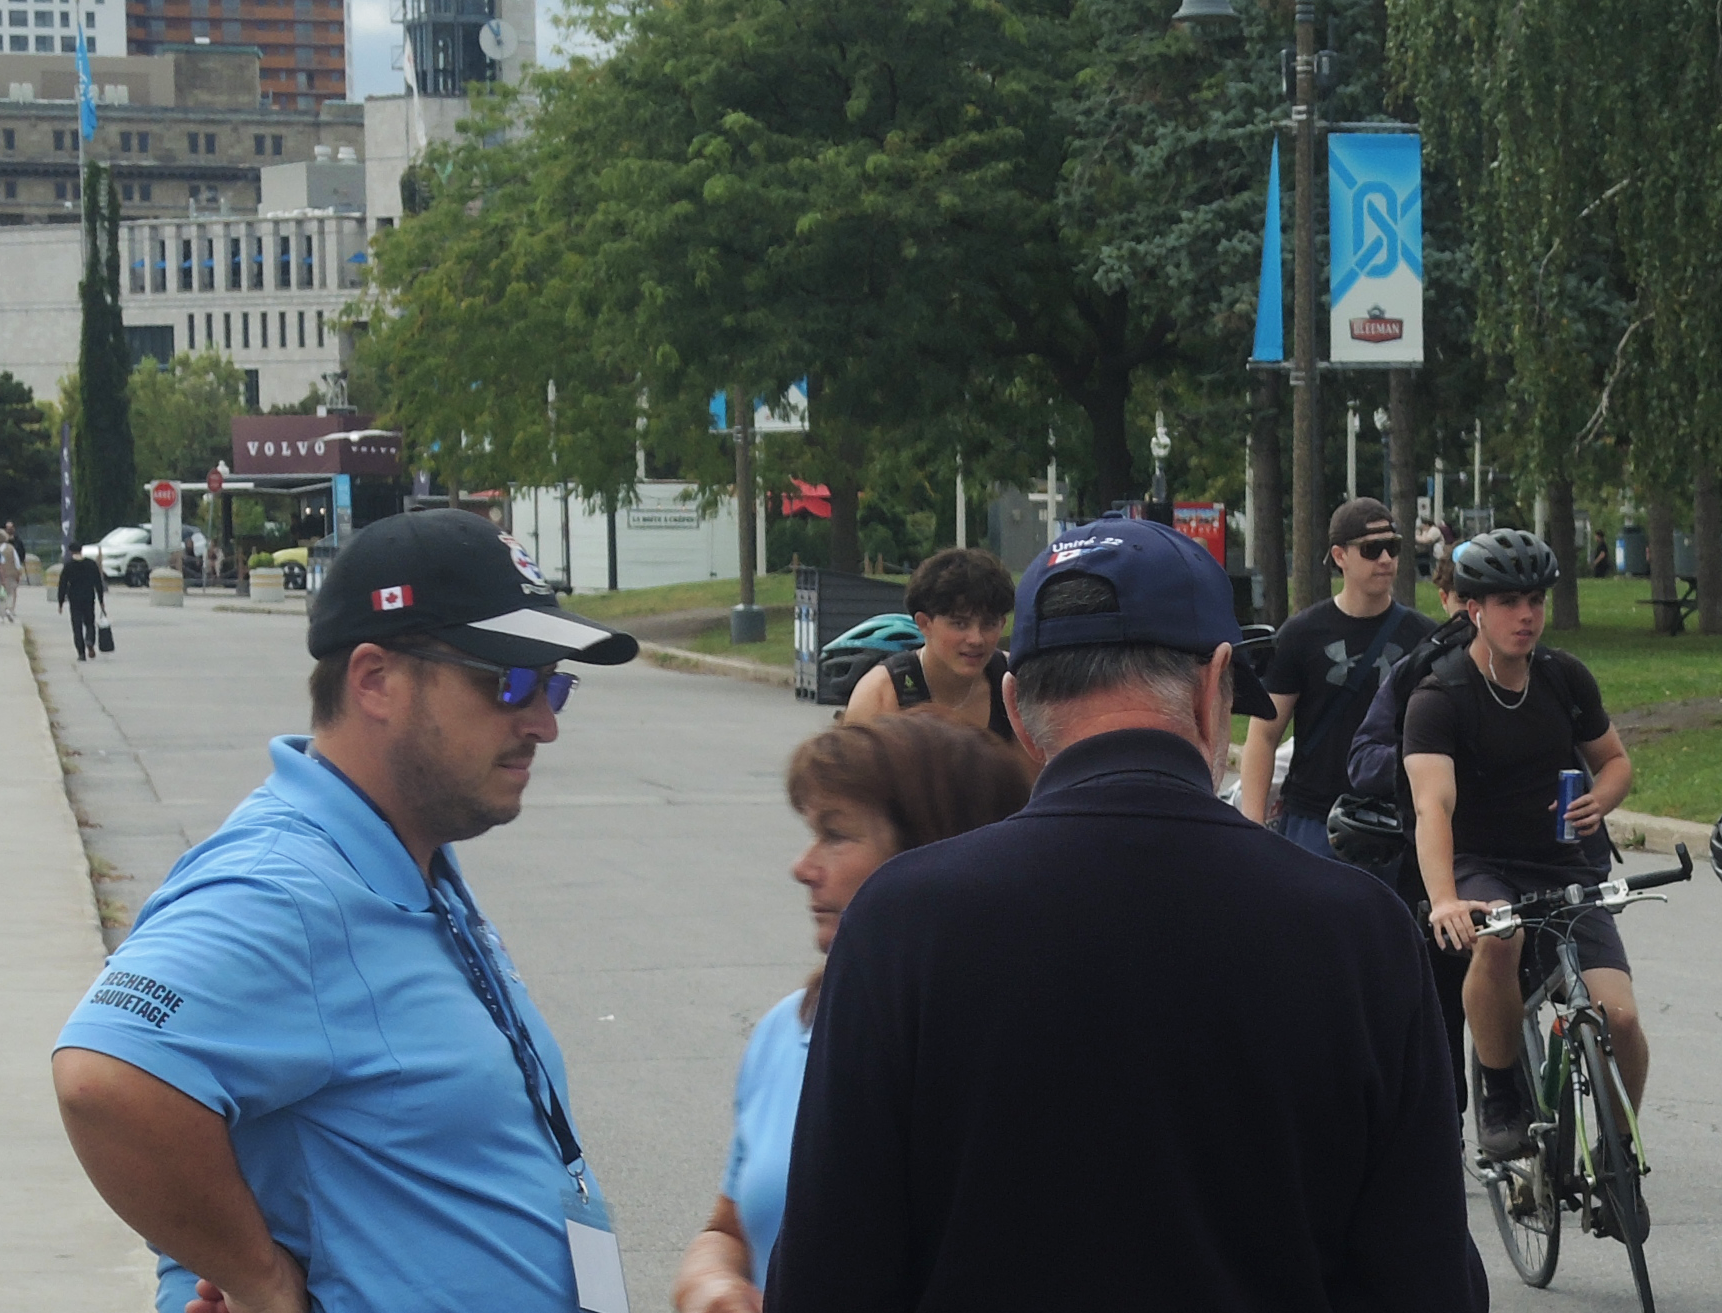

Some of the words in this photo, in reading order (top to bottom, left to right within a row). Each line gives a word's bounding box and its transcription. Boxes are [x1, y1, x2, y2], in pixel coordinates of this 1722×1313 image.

[247, 441, 326, 457] VOLVO
[90, 988, 170, 1029] SAUVETAGE
[101, 971, 184, 1014] RECHERCHE
